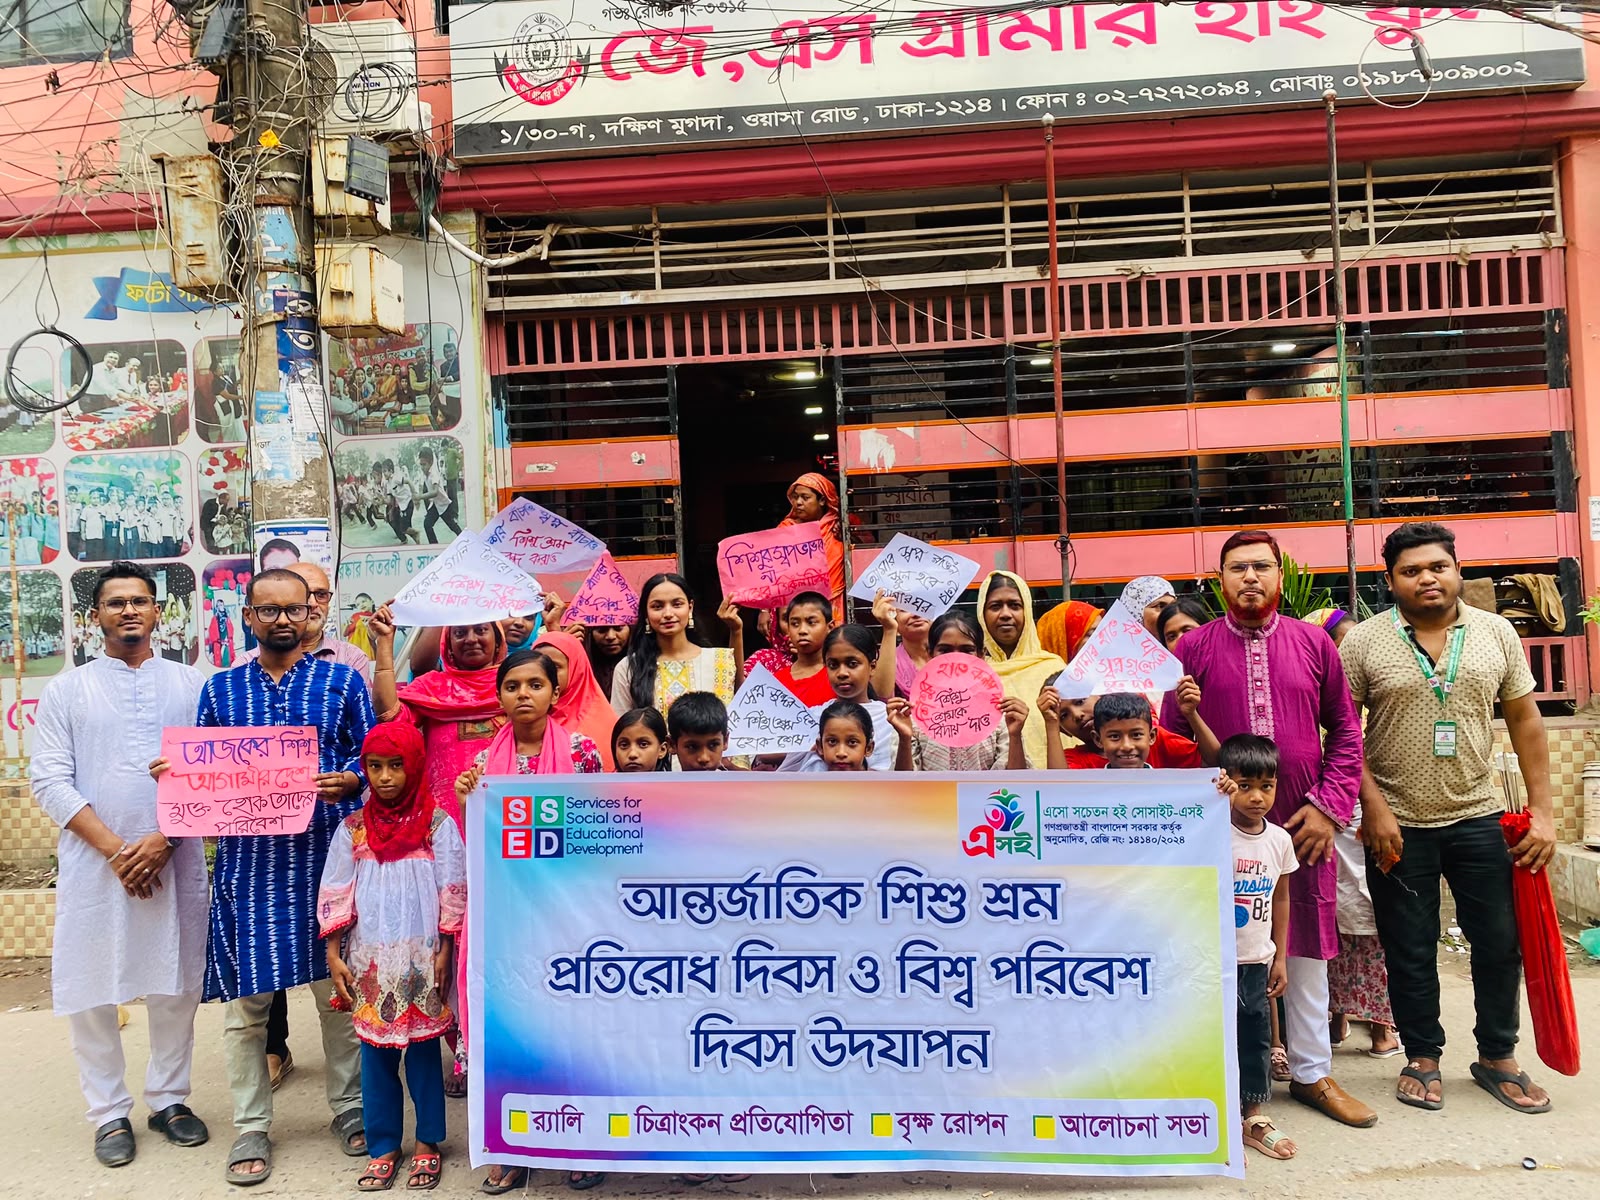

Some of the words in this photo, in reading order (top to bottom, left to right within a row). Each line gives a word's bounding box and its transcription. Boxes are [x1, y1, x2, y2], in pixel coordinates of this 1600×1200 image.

[602, 116, 663, 137] দক্ষিণ
[670, 111, 734, 138] মুগদা,
[741, 107, 804, 128] ওয়াসা
[1016, 92, 1069, 110] ফোন
[1269, 73, 1335, 95] মোবাঃ
[125, 281, 171, 303] ফটো
[365, 552, 400, 577] বিতরণী
[566, 797, 620, 810] Services
[624, 796, 642, 809] for
[1043, 806, 1068, 818] এসো
[1072, 805, 1109, 820] সচেতন
[1112, 804, 1128, 820] হই
[566, 813, 608, 825] Social
[613, 812, 642, 824] and
[1092, 822, 1128, 832] বাংলাদেশ
[1131, 823, 1157, 832] সরকার
[566, 827, 643, 840] Educational
[1091, 832, 1108, 844] রেজি
[566, 842, 643, 857] Development
[621, 866, 864, 924] আন্তর্জাতিক
[877, 866, 966, 924] শিশু
[983, 882, 1061, 920] শ্রম
[1234, 876, 1273, 898] arsity
[549, 940, 718, 994] প্রতিরোধ
[732, 939, 836, 994] দিবস
[849, 955, 879, 994] ও
[897, 939, 976, 1008] বিশ্ব
[990, 940, 1151, 996] পরিবেশ
[690, 1013, 796, 1068] দিবস
[810, 1016, 990, 1068] উদযাপন
[634, 1105, 724, 1137] চিত্রাংকন
[730, 1105, 853, 1136] প্রতিযোগিতা
[895, 1112, 934, 1143] বৃক্ষ
[941, 1112, 1008, 1136] রোপন
[1060, 1113, 1159, 1139] আলোচনা
[1166, 1115, 1210, 1139] সভা
